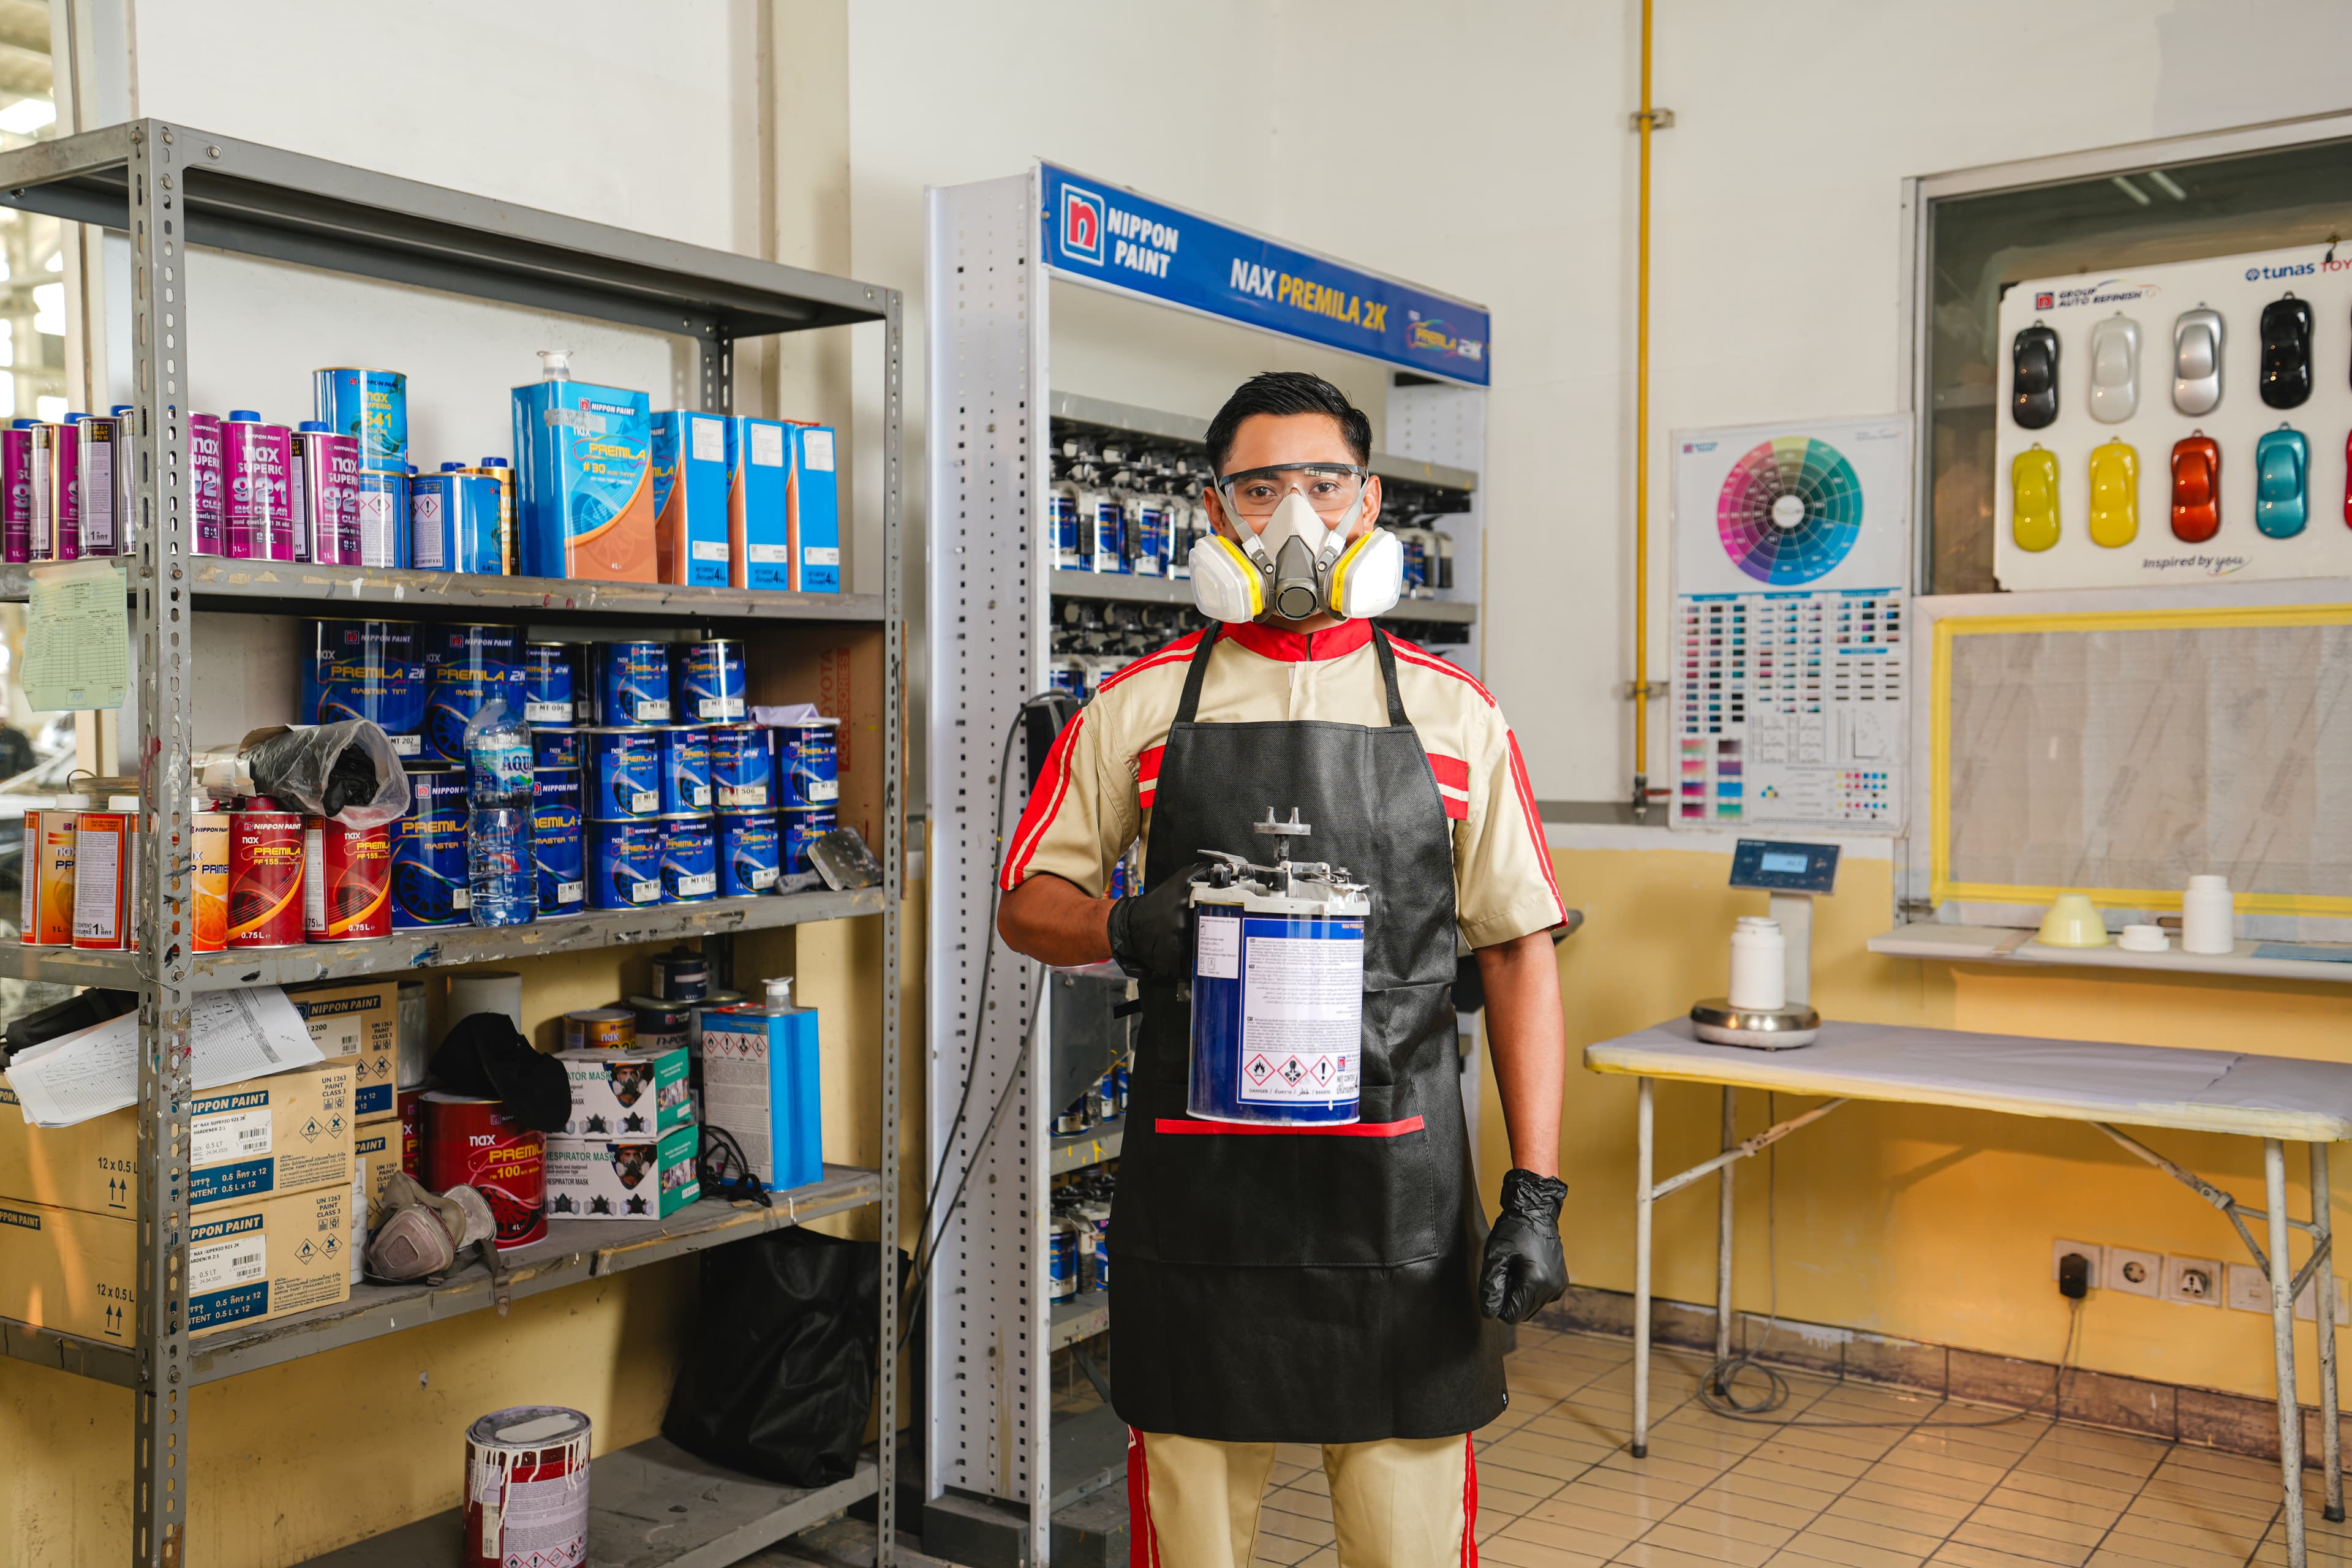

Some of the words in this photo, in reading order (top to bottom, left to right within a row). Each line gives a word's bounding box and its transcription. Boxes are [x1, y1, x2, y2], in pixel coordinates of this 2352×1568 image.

[1107, 207, 1178, 253] NIPPON
[1114, 239, 1170, 279] PAINT
[2262, 263, 2315, 279] tunas
[1230, 258, 1276, 300] NAX
[1277, 273, 1360, 325] PREMILA
[1362, 301, 1388, 333] 2K
[2058, 297, 2089, 307] AUTO
[2093, 291, 2141, 304] REFINISH
[2059, 288, 2096, 298] GROUP
[366, 391, 388, 403] nax
[591, 404, 616, 412] NIPPON
[617, 405, 635, 415] PAINT
[364, 412, 392, 428] 541
[242, 445, 280, 463] nax
[589, 443, 646, 459] PREMILA
[331, 456, 358, 473] nax
[232, 476, 287, 505] 921
[235, 505, 251, 514] 2K
[254, 505, 287, 516] CLEAR
[343, 539, 358, 549] 2:1
[2143, 555, 2196, 571] Inspired
[2198, 555, 2214, 568] by
[2215, 556, 2245, 573] you
[331, 666, 403, 679] PREMILA
[437, 669, 505, 681] PREMILA
[820, 648, 833, 718] OYOTA
[839, 654, 848, 764] ACCESSORIES
[743, 748, 760, 758] 2K
[500, 755, 533, 774] AQUA
[254, 847, 301, 856] PREMILA
[424, 842, 458, 850] MASTER
[55, 861, 75, 870] PP
[311, 1001, 349, 1014] NIPPON
[350, 998, 379, 1009] PAINT
[601, 1033, 620, 1042] nax
[589, 1071, 612, 1082] MASK
[231, 1093, 266, 1107] PAINT
[355, 1139, 383, 1152] PAINT
[469, 1134, 496, 1147] nax
[593, 1152, 616, 1162] MASK
[97, 1157, 108, 1170] 12
[110, 1162, 116, 1170] x
[118, 1161, 131, 1173] 0.5
[497, 1165, 521, 1178] 100
[222, 1173, 233, 1182] 0.5
[190, 1187, 217, 1199] NTENT
[222, 1185, 233, 1193] 0.5
[18, 1215, 40, 1227] PAINT
[191, 1224, 223, 1240] PPON
[225, 1217, 260, 1231] PAINT
[97, 1283, 107, 1296] 12
[115, 1287, 127, 1301] 0.5
[129, 1289, 134, 1303] L
[189, 1305, 204, 1315] รรจุ
[189, 1314, 211, 1325] TENT
